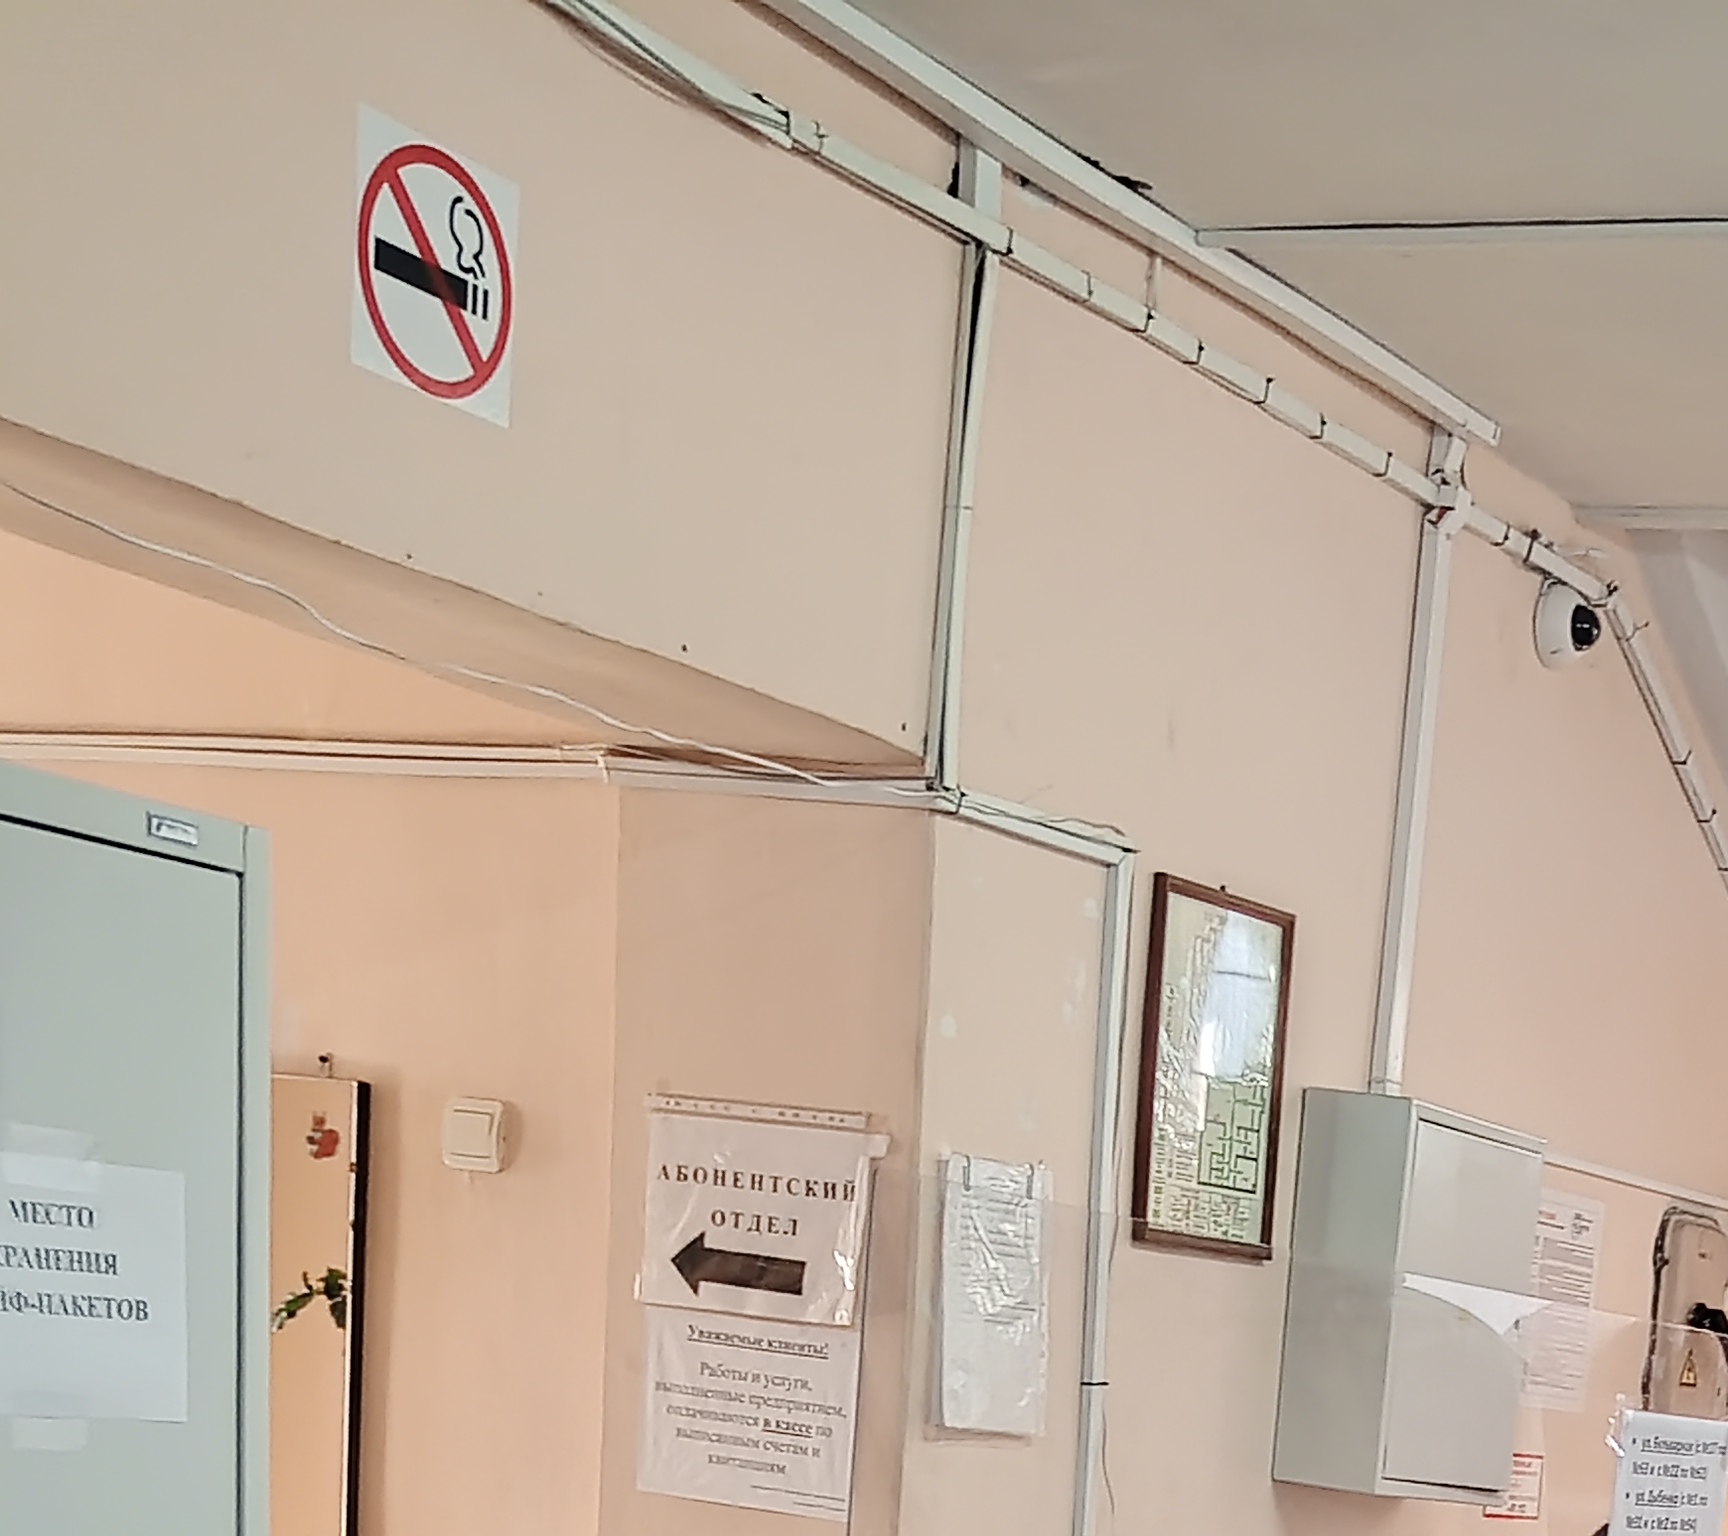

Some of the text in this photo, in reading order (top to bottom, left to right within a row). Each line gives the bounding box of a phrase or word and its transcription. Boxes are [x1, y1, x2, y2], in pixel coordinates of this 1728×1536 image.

[657, 1164, 857, 1202] АБОНЕНТСКИЙ
[8, 1199, 95, 1228] МЕСТО
[710, 1209, 799, 1237] ОТДЕЛ
[0, 1244, 118, 1276] РАНЕНИЯ
[699, 1361, 750, 1382] Работы
[752, 1372, 762, 1384] и
